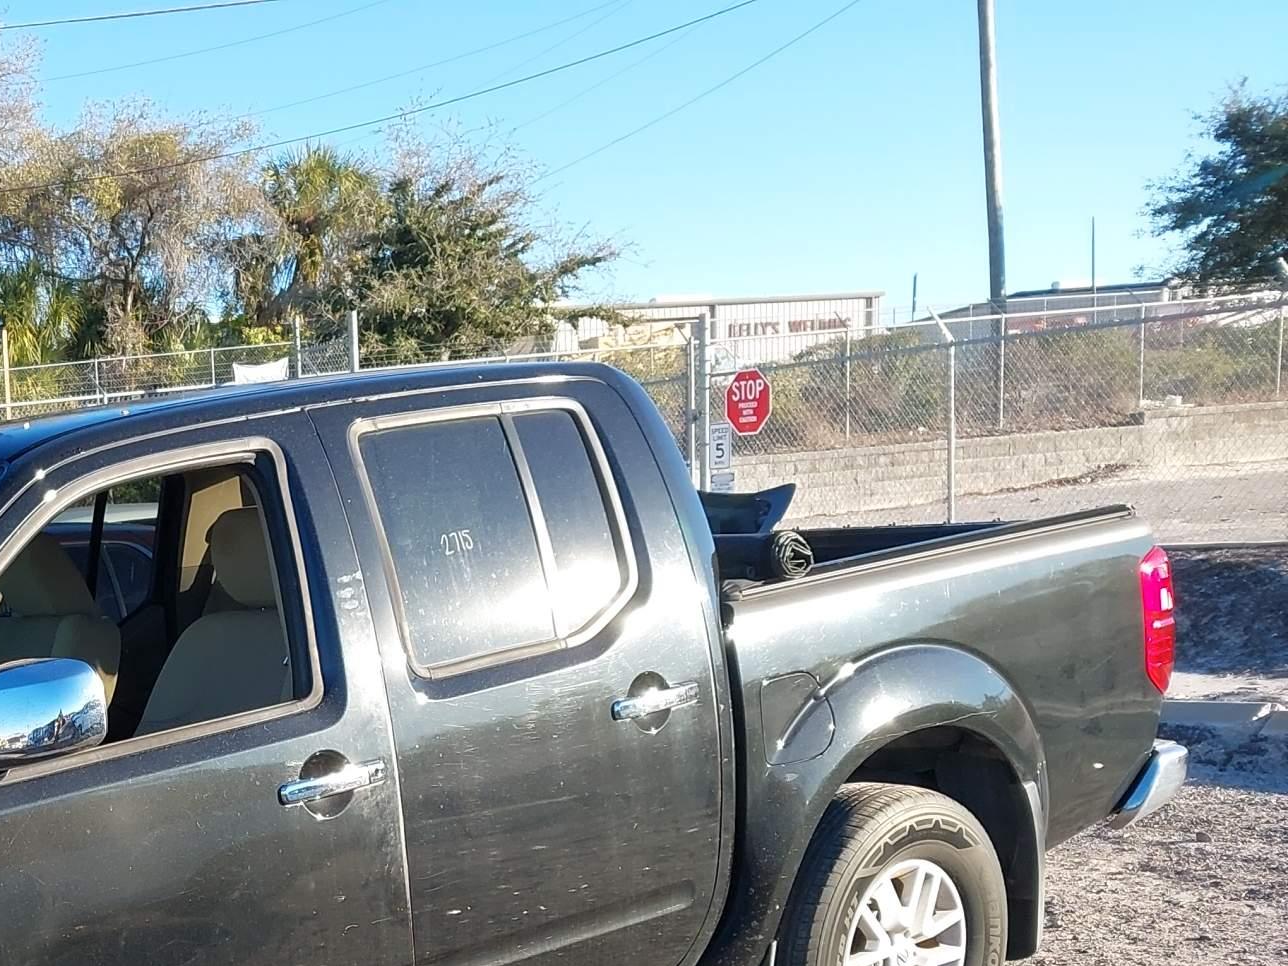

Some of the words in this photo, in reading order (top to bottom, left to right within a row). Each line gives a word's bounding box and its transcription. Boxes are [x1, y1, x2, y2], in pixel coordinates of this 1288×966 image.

[732, 379, 765, 402] STOP
[712, 434, 727, 442] LIMIT
[715, 442, 725, 459] 5
[440, 529, 474, 556] 2715
